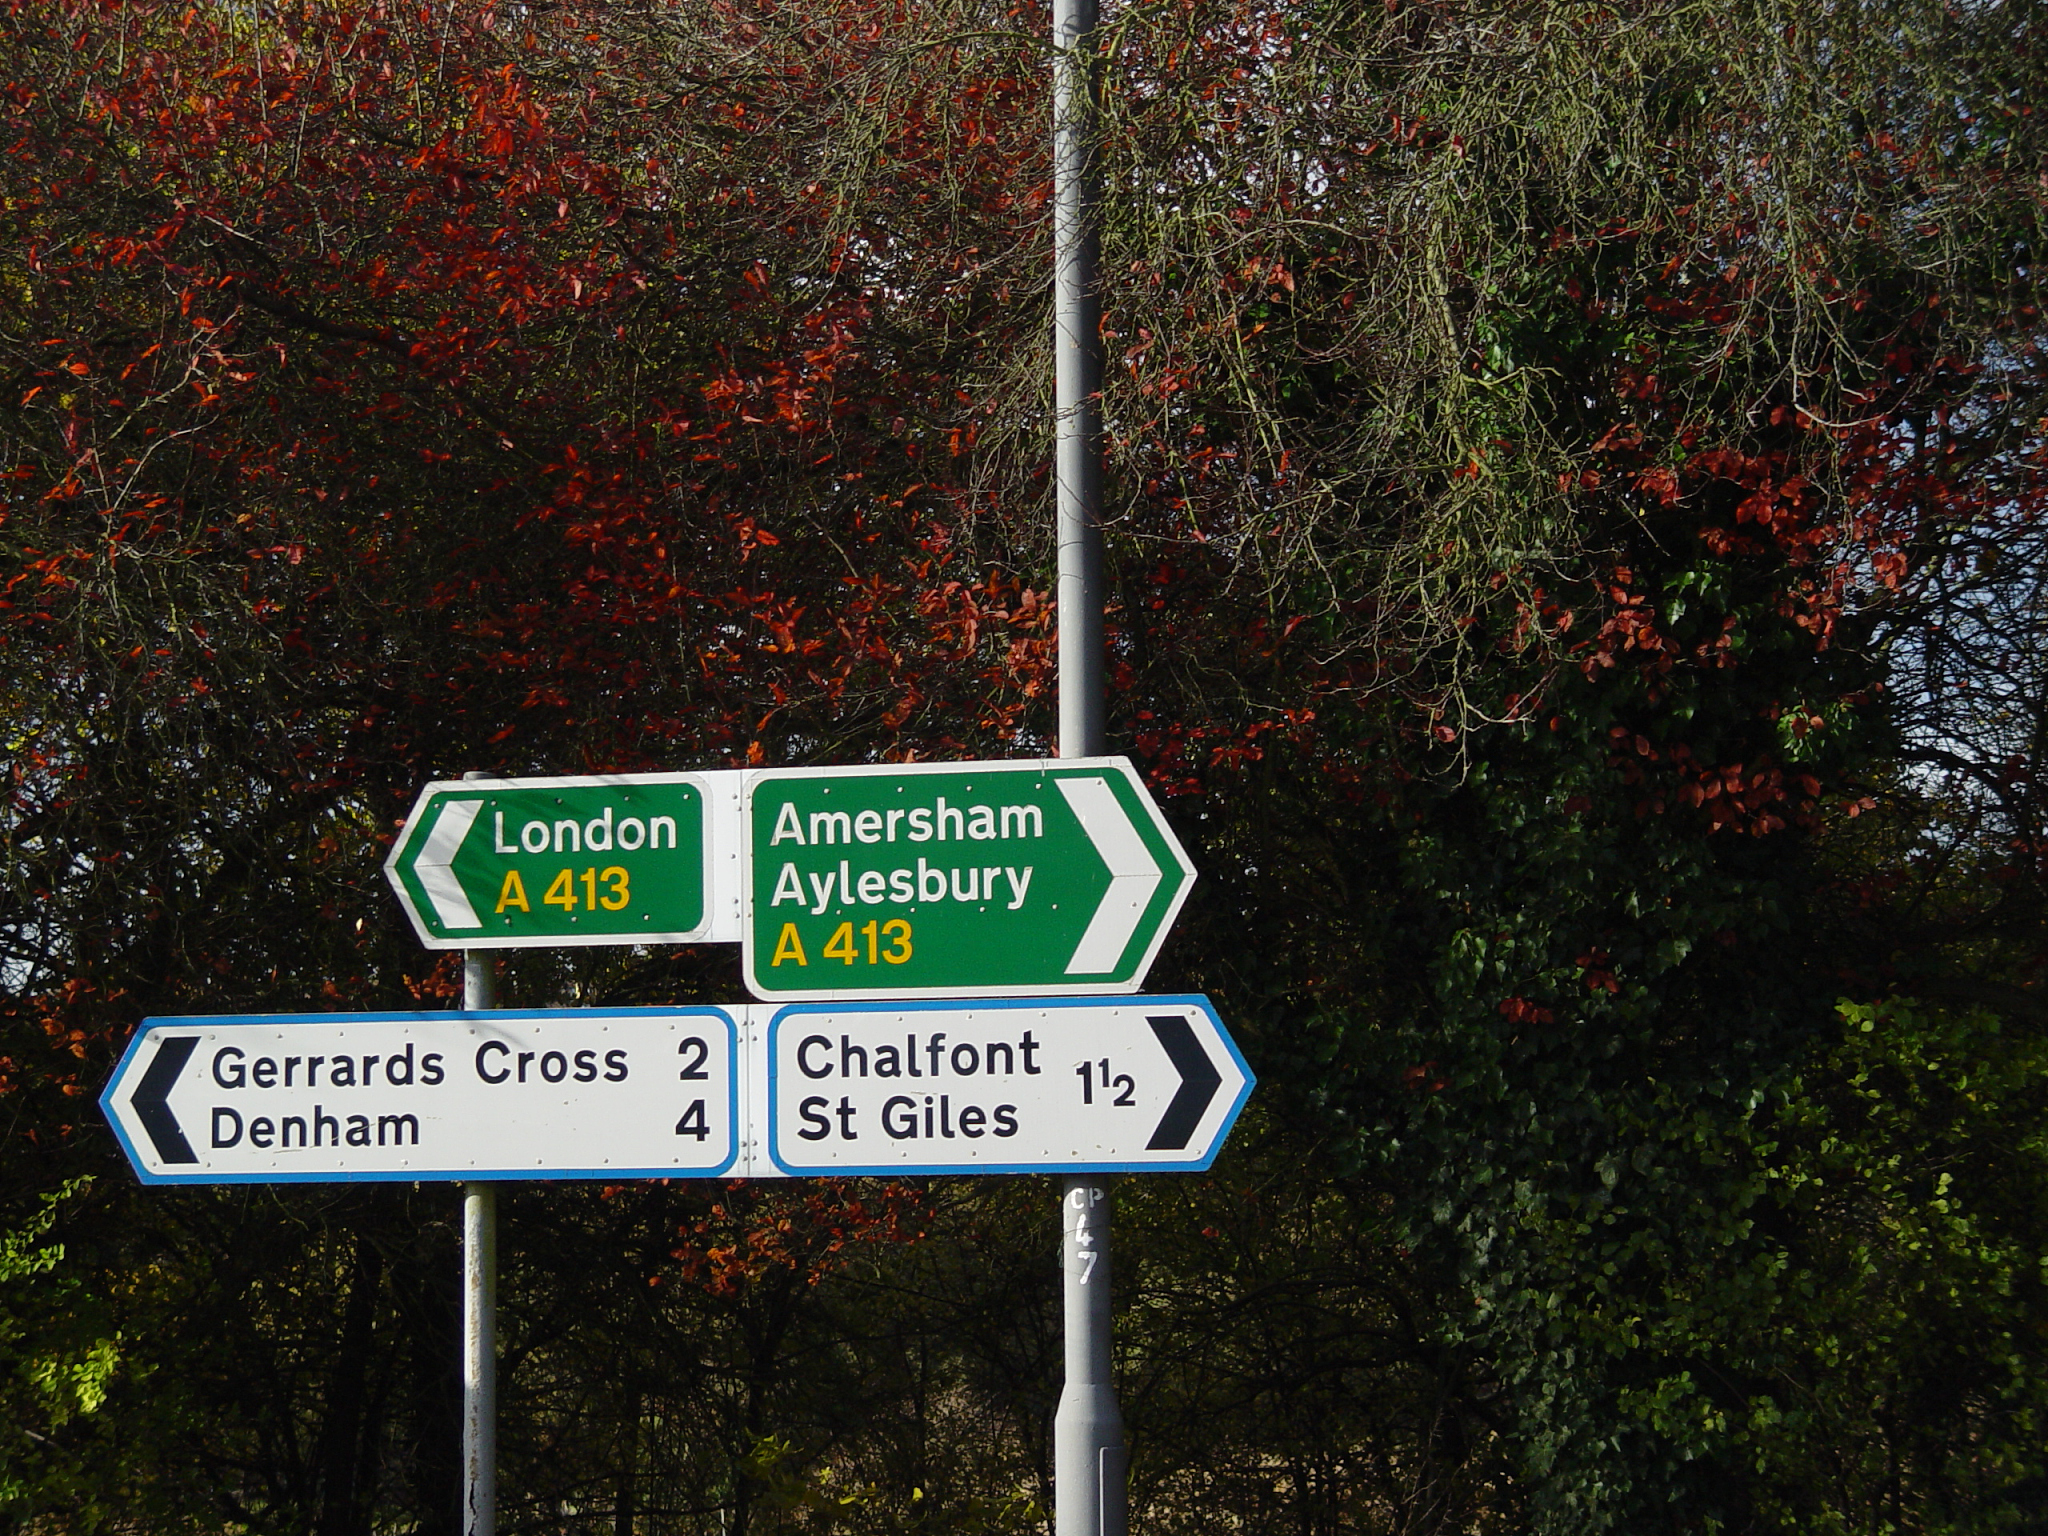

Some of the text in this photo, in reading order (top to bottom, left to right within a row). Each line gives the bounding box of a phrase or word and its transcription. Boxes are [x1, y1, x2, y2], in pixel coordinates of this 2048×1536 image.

[494, 806, 677, 854] London
[769, 797, 1044, 846] Amersham
[494, 865, 631, 914] A 413
[770, 857, 1034, 915] Aylesbury
[771, 918, 914, 967] A 413
[210, 1036, 710, 1090] Gerrards Cross 2
[796, 1029, 1042, 1080] Chalfont
[210, 1098, 712, 1149] Denham 4
[797, 1094, 1019, 1141] St Giles
[1070, 1187, 1105, 1210] CP
